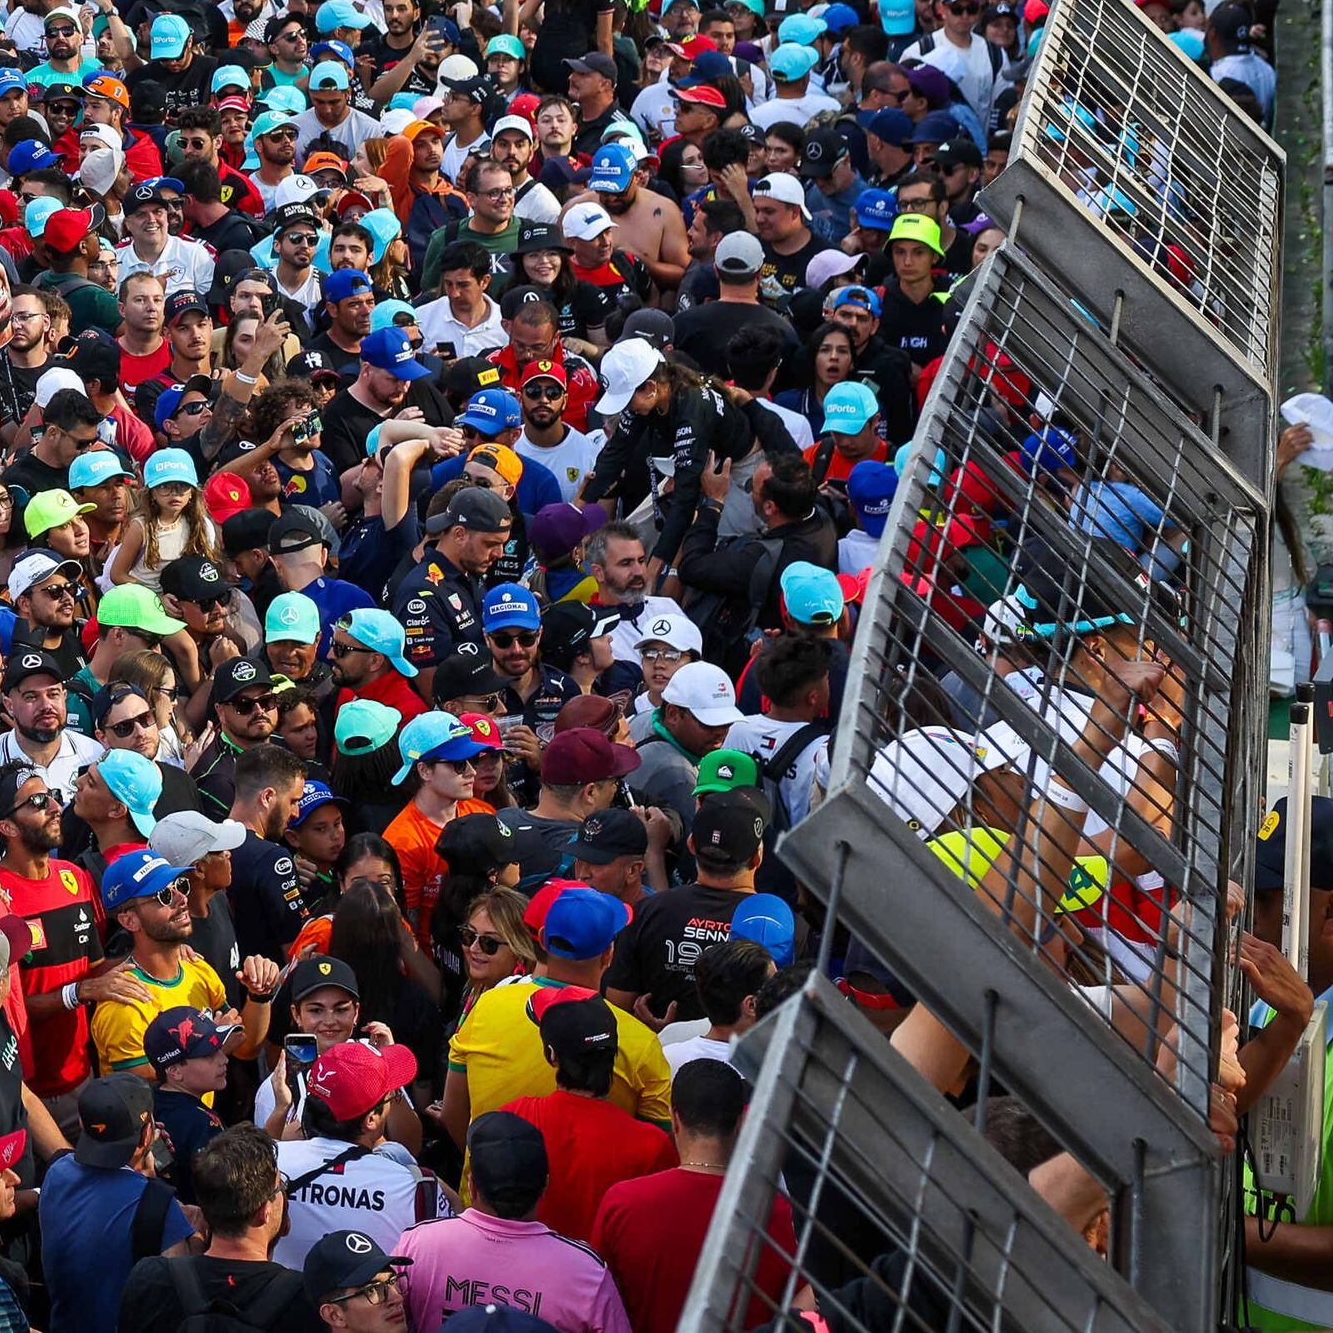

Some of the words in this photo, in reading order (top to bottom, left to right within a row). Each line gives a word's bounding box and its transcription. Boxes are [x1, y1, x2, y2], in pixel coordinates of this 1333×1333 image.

[834, 404, 856, 413] Porto
[164, 461, 189, 470] Porto
[491, 604, 526, 613] NACIONAL
[687, 918, 731, 930] AYRTO
[684, 926, 730, 942] SENN
[664, 940, 701, 964] 19
[157, 1047, 181, 1063] CarNext
[289, 1179, 384, 1211] ETRONAS
[445, 1275, 542, 1317] MESSI
